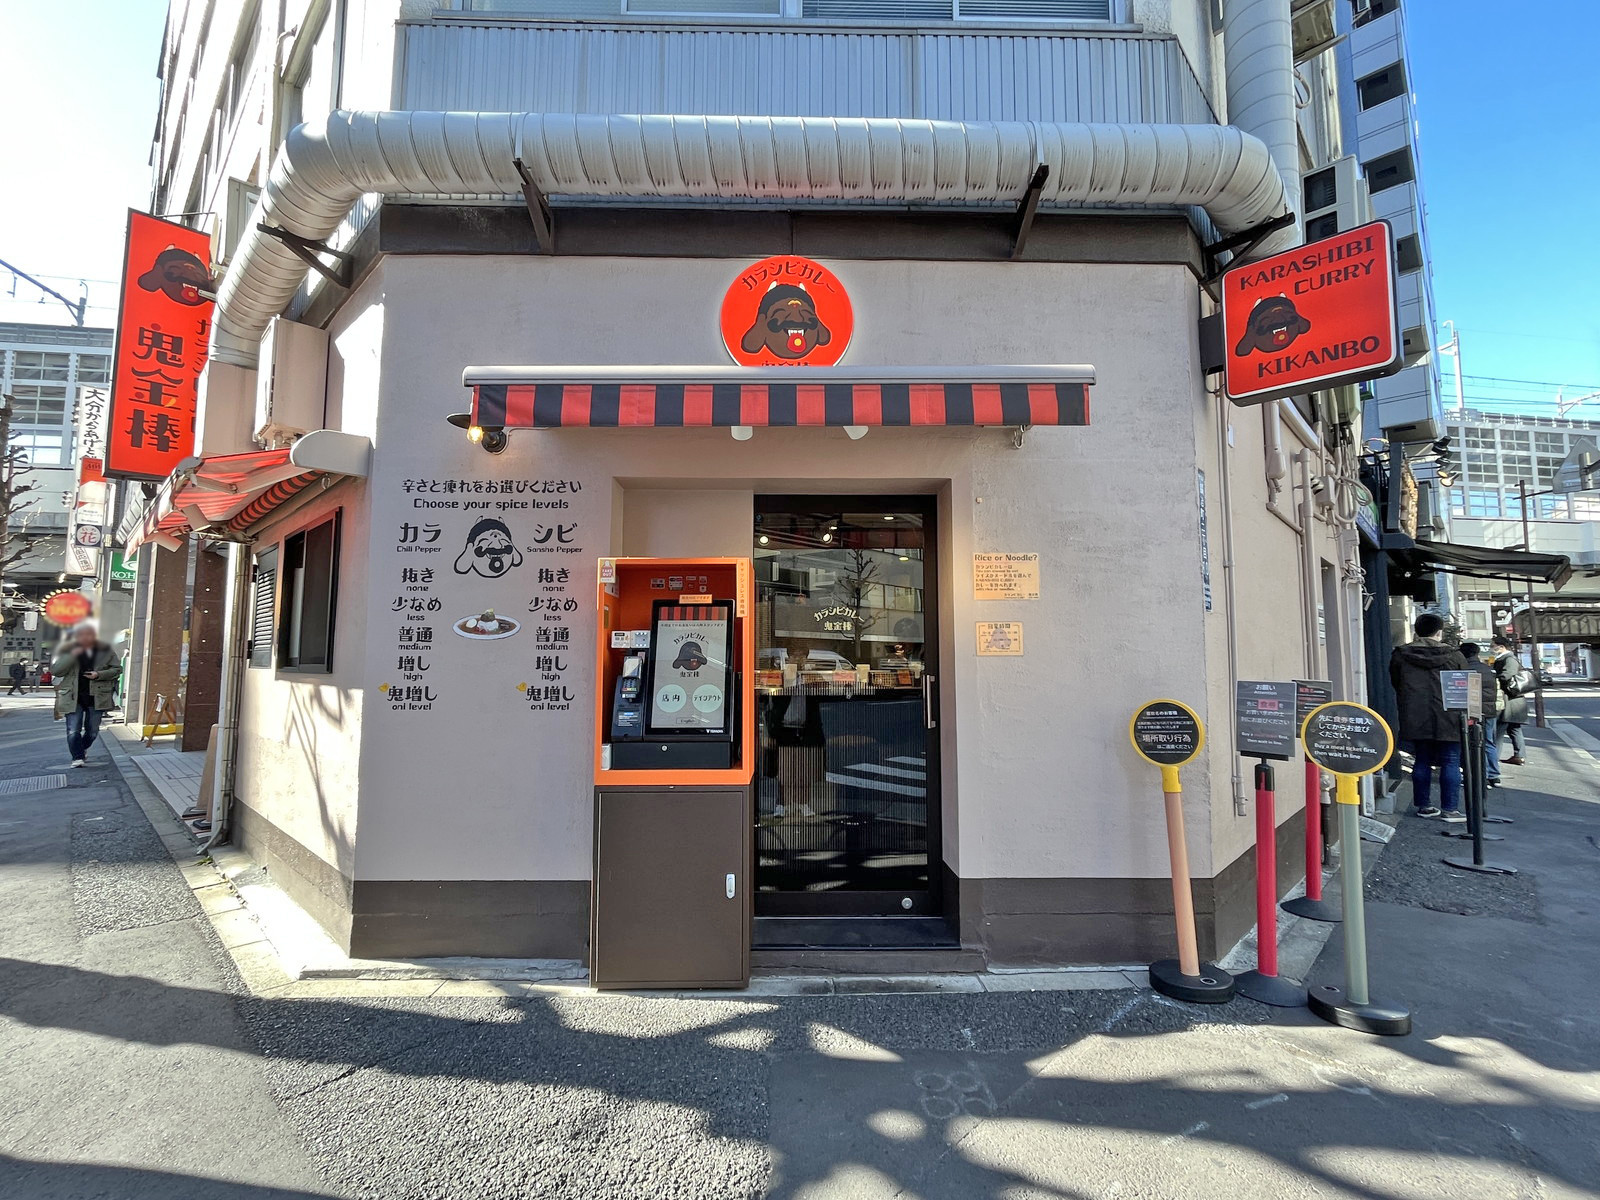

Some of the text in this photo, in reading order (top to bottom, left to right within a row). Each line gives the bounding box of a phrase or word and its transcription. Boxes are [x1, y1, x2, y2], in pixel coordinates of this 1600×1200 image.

[1240, 235, 1375, 291] KARASHIBI
[741, 261, 836, 293] カラシビカレー
[1294, 258, 1376, 296] CURRY
[1257, 335, 1380, 378] KIKANBO
[124, 322, 186, 453] 鬼金棒
[82, 389, 105, 460] 大分からあげと
[402, 478, 583, 494] 辛さと痺れをお選びください
[413, 498, 569, 511] Choose your spice levels
[398, 522, 442, 543] カラ
[533, 522, 578, 544] シビ
[414, 545, 442, 554] Pepper
[526, 545, 583, 554] Sansho Pepper
[974, 554, 993, 562] Rice
[1005, 554, 1038, 562] Noodle?
[401, 567, 435, 584] 抜き
[538, 567, 571, 584] 抜き
[391, 596, 442, 612] 少なめ
[528, 596, 578, 612] 少なめ
[406, 613, 425, 621] less
[543, 613, 562, 621] less
[813, 606, 866, 622] カラシビカレー
[398, 625, 433, 643] 普通
[535, 625, 570, 643] 普通
[398, 643, 432, 651] medium
[535, 643, 569, 651] medium
[397, 655, 431, 672] 増し
[535, 655, 568, 672] 増し
[403, 672, 423, 682] high
[541, 672, 561, 682] high
[387, 685, 438, 702] 鬼増し
[525, 685, 575, 702] 鬼増し
[391, 702, 432, 711] oni level
[530, 702, 570, 711] oni level
[1318, 715, 1372, 726] 先に食券を購入
[1318, 723, 1371, 734] してからお並び
[1142, 733, 1192, 743] 場所取り行為
